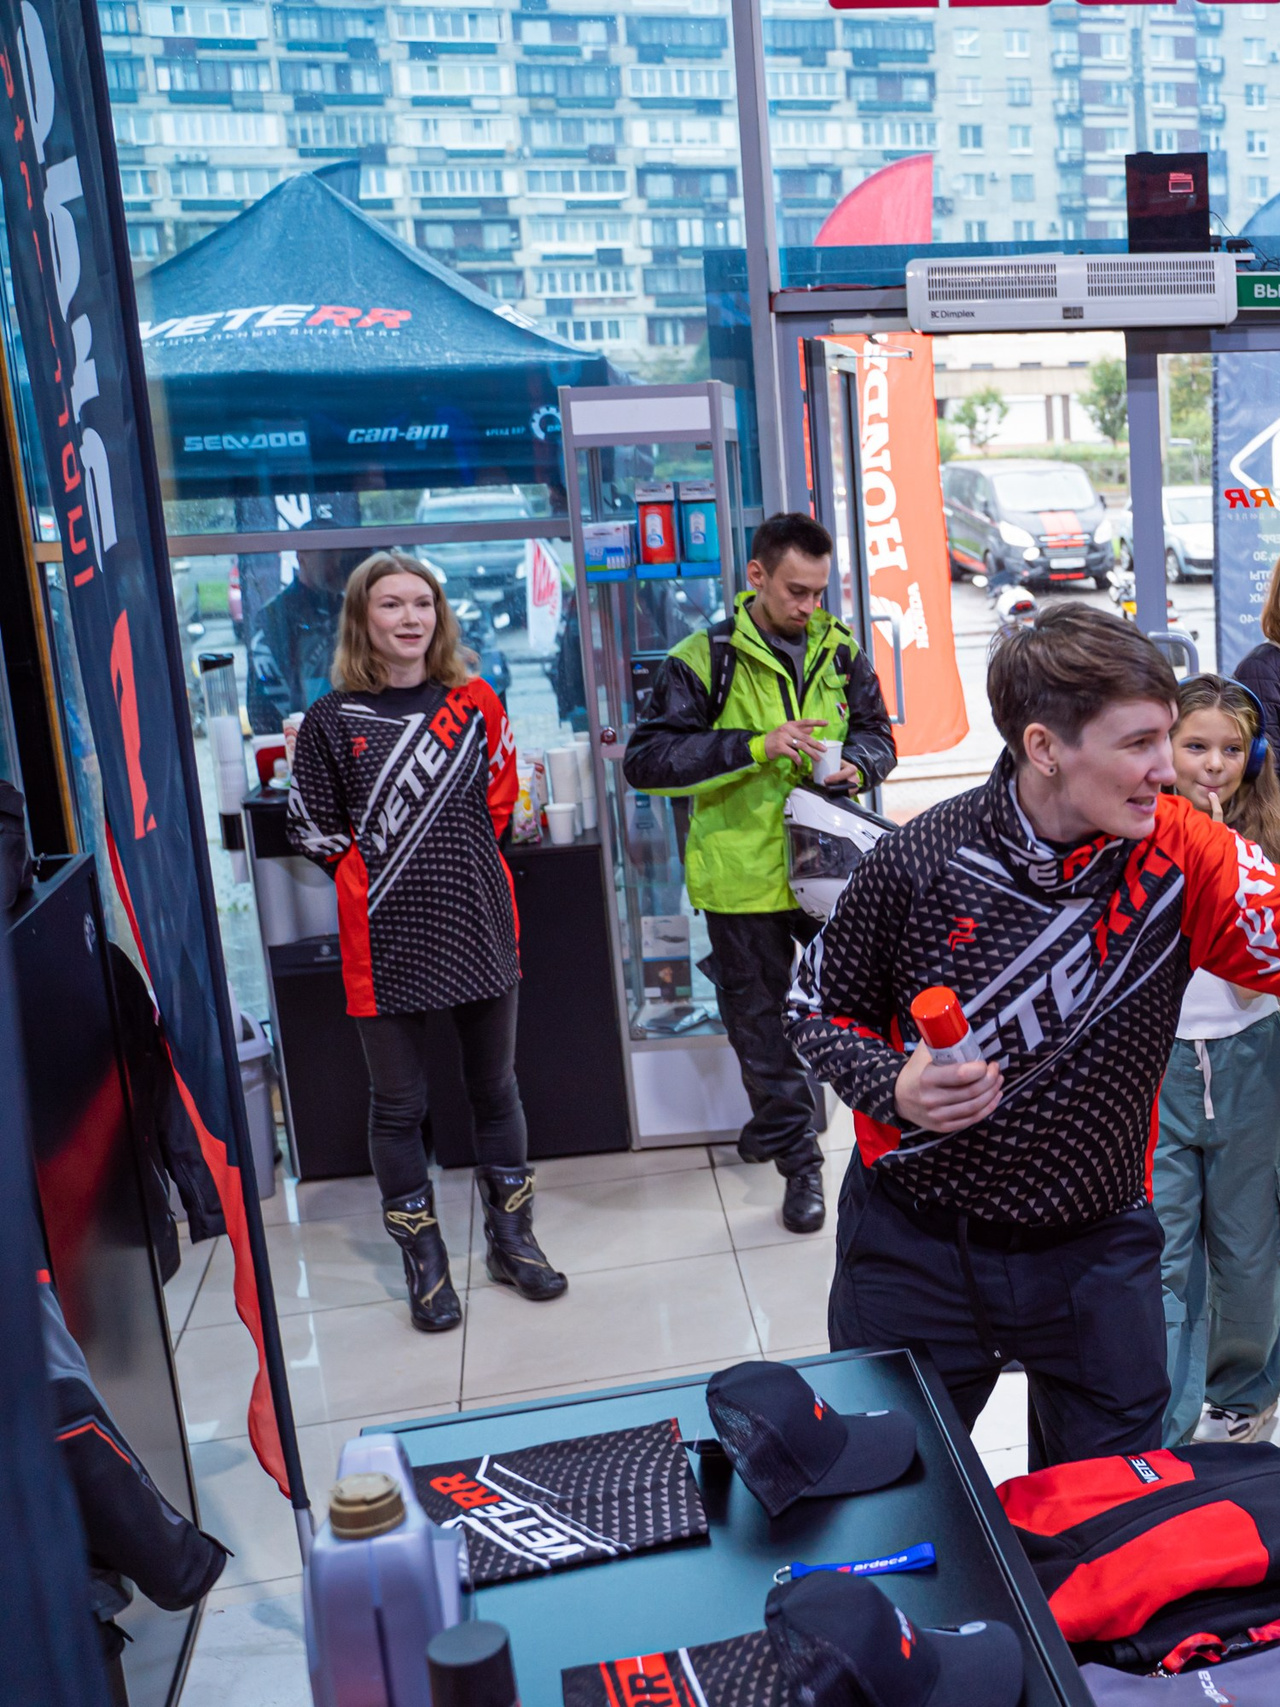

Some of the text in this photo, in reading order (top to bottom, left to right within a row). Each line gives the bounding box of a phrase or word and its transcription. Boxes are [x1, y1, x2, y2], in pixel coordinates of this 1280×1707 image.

[139, 304, 412, 340] VETERR
[940, 310, 976, 319] Dimplex
[347, 424, 449, 444] can-am
[862, 333, 908, 578] HONDA
[371, 686, 476, 855] VETERR
[430, 1472, 586, 1560] VETERR
[853, 1555, 908, 1572] ardeca
